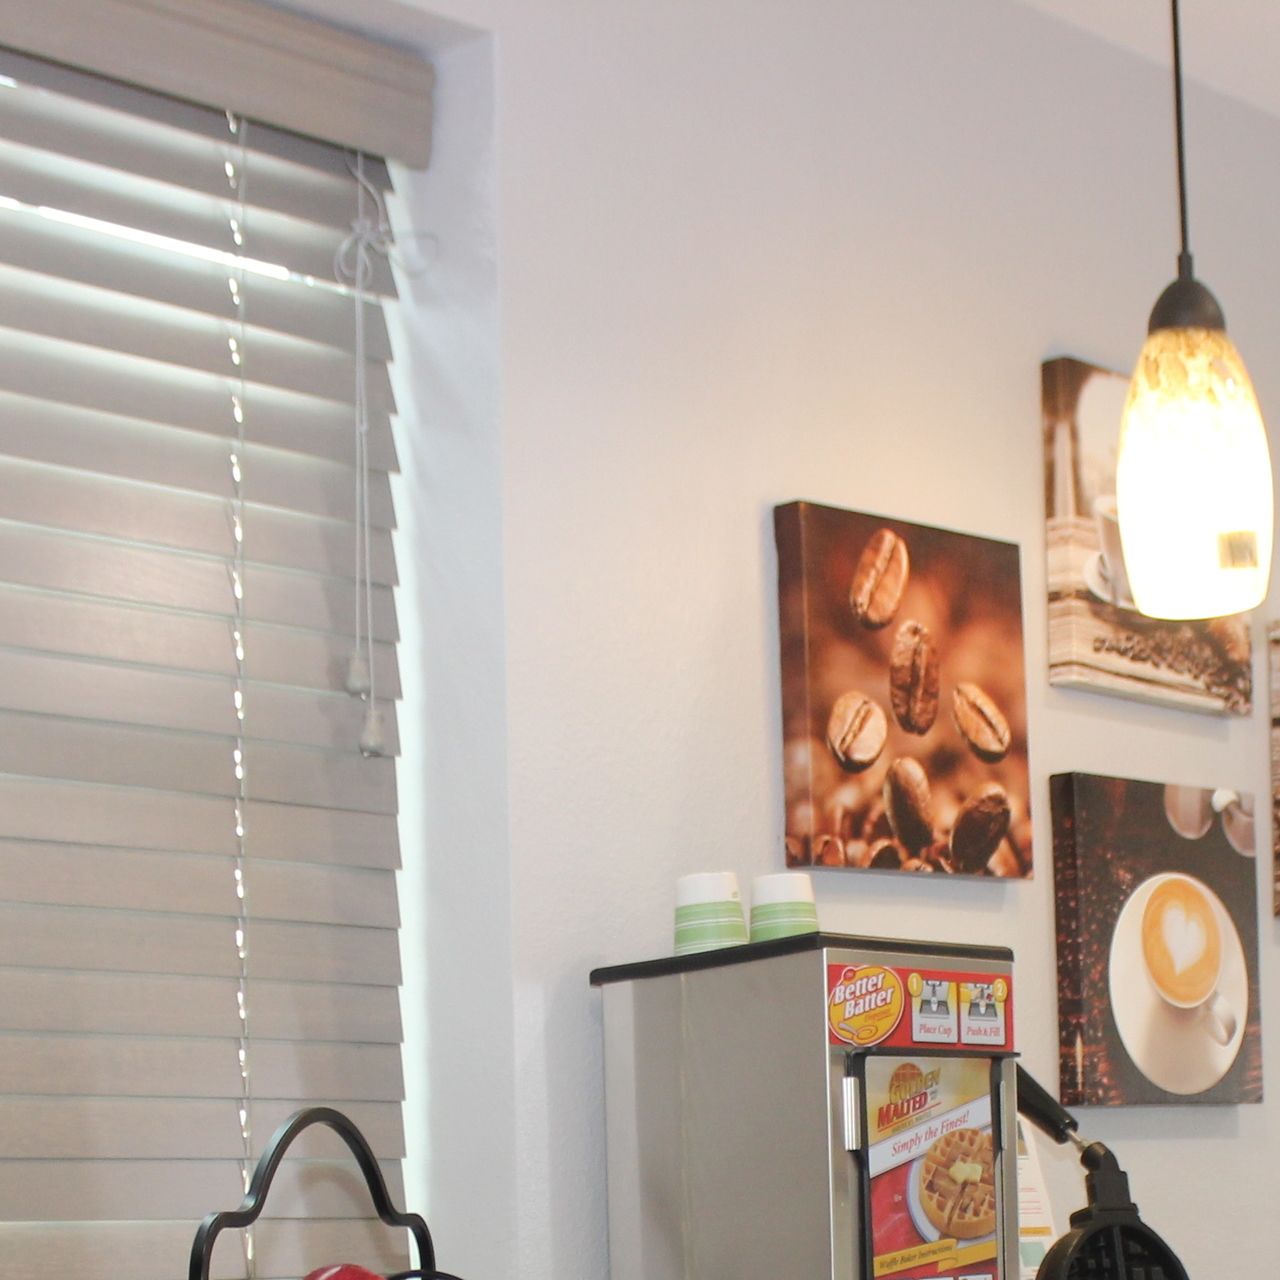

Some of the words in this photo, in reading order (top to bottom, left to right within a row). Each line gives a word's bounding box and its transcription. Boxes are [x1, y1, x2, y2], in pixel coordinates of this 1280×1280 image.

[833, 972, 886, 1005] Better
[843, 986, 895, 1020] Batter
[876, 1090, 930, 1130] MALTED
[891, 1135, 924, 1158] Simply
[923, 1124, 940, 1141] the
[940, 1109, 971, 1136] Finest!
